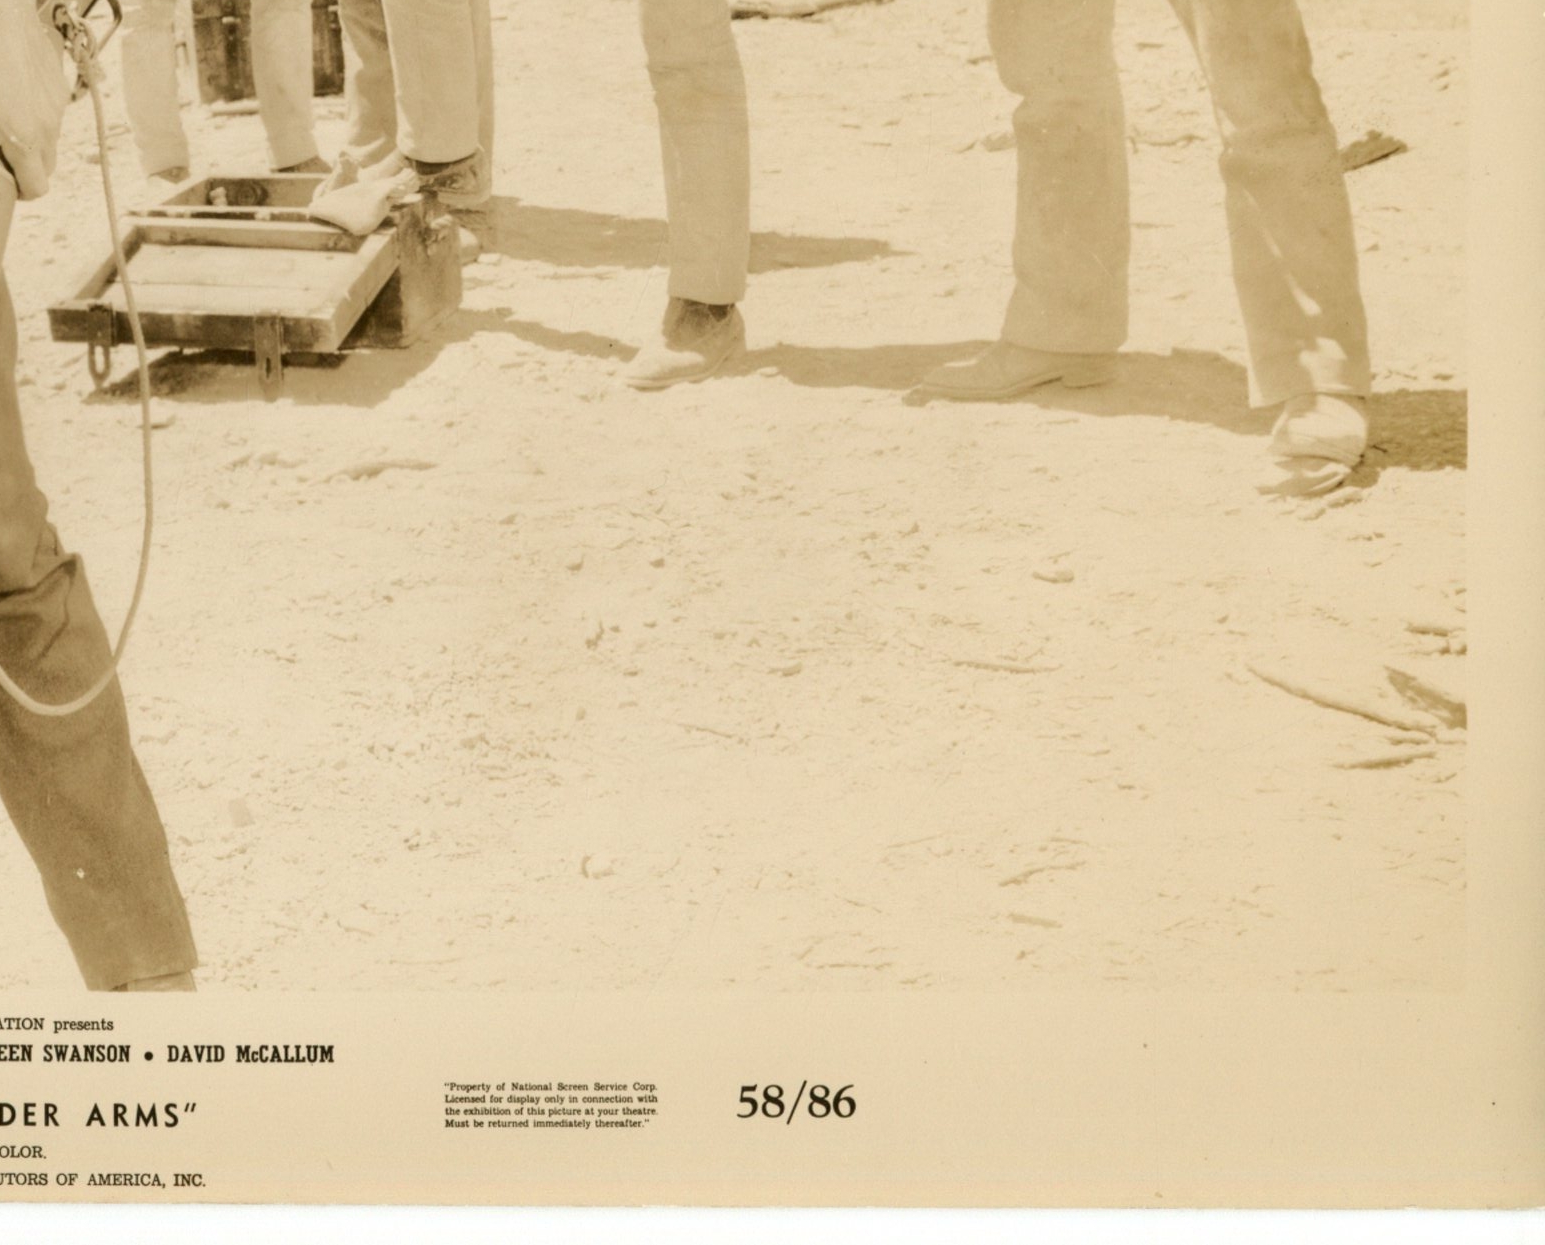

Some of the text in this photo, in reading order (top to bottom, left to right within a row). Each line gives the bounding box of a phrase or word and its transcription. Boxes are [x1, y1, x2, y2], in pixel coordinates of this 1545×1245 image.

[52, 1017, 115, 1035] presents
[42, 1043, 131, 1063] SWANSON
[166, 1044, 226, 1064] DAVID
[235, 1044, 335, 1064] McCALLUM
[443, 1081, 658, 1094] "Property of National Screen Service Corp.
[444, 1093, 659, 1106] Licensed for display only in connection with
[736, 1079, 857, 1125] 58/86
[85, 1102, 197, 1129] ARMS"
[444, 1106, 659, 1119] the exhibition of this picture at your theatre.
[444, 1118, 651, 1131] Must be returned immediately thereafter."
[55, 1172, 79, 1187] OF
[86, 1172, 167, 1190] AMERICA,
[172, 1173, 207, 1188] INC.
